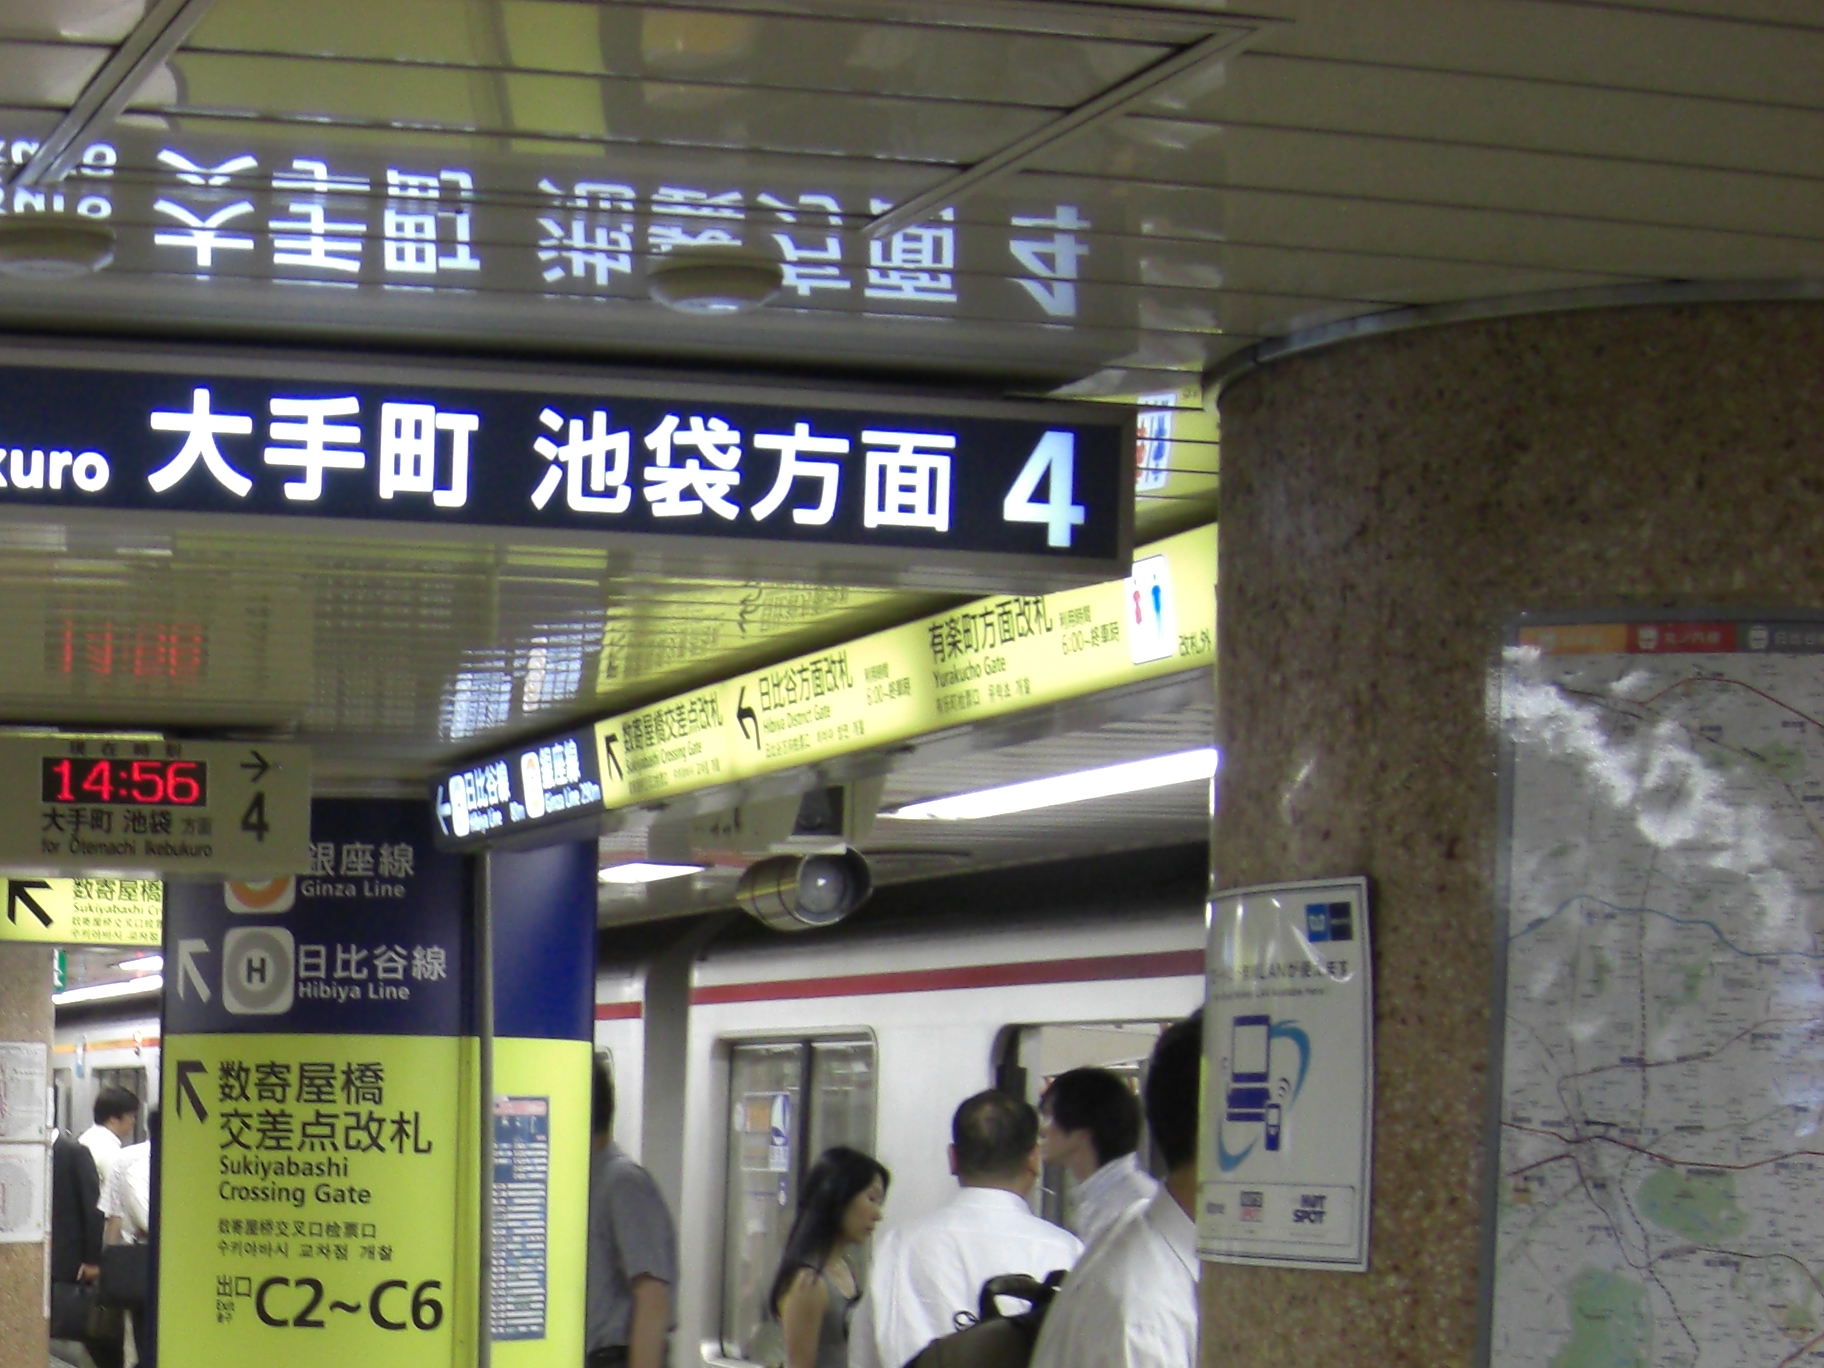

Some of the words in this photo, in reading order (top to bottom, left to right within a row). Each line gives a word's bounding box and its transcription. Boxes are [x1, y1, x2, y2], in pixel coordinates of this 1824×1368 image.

[148, 389, 479, 508] 大手町
[530, 409, 957, 531] 池袋方面
[1002, 430, 1085, 548] 4
[759, 650, 853, 712] 日比谷方面改札
[932, 661, 982, 689] Yurakucho
[984, 656, 1006, 677] Gate
[53, 759, 200, 804] 14:56
[42, 807, 113, 833] 大手町
[123, 809, 173, 836] 池袋
[241, 791, 269, 842] 4
[42, 838, 61, 854] for
[69, 837, 136, 856] Otemachi
[145, 839, 213, 857] Ikebukuro
[300, 880, 357, 898] Ginza
[363, 880, 406, 898] Line
[298, 944, 447, 981] 日比谷線
[298, 982, 361, 1003] Hibiya
[368, 982, 410, 1000] Line
[218, 1059, 384, 1105] 数寄屋橋
[219, 1108, 433, 1154] 交差点改札
[219, 1155, 349, 1180] Sukiyabashi
[219, 1182, 305, 1207] Crossing
[315, 1183, 371, 1204] Gate
[216, 1275, 252, 1299] 出口
[255, 1276, 443, 1331] C2~C6
